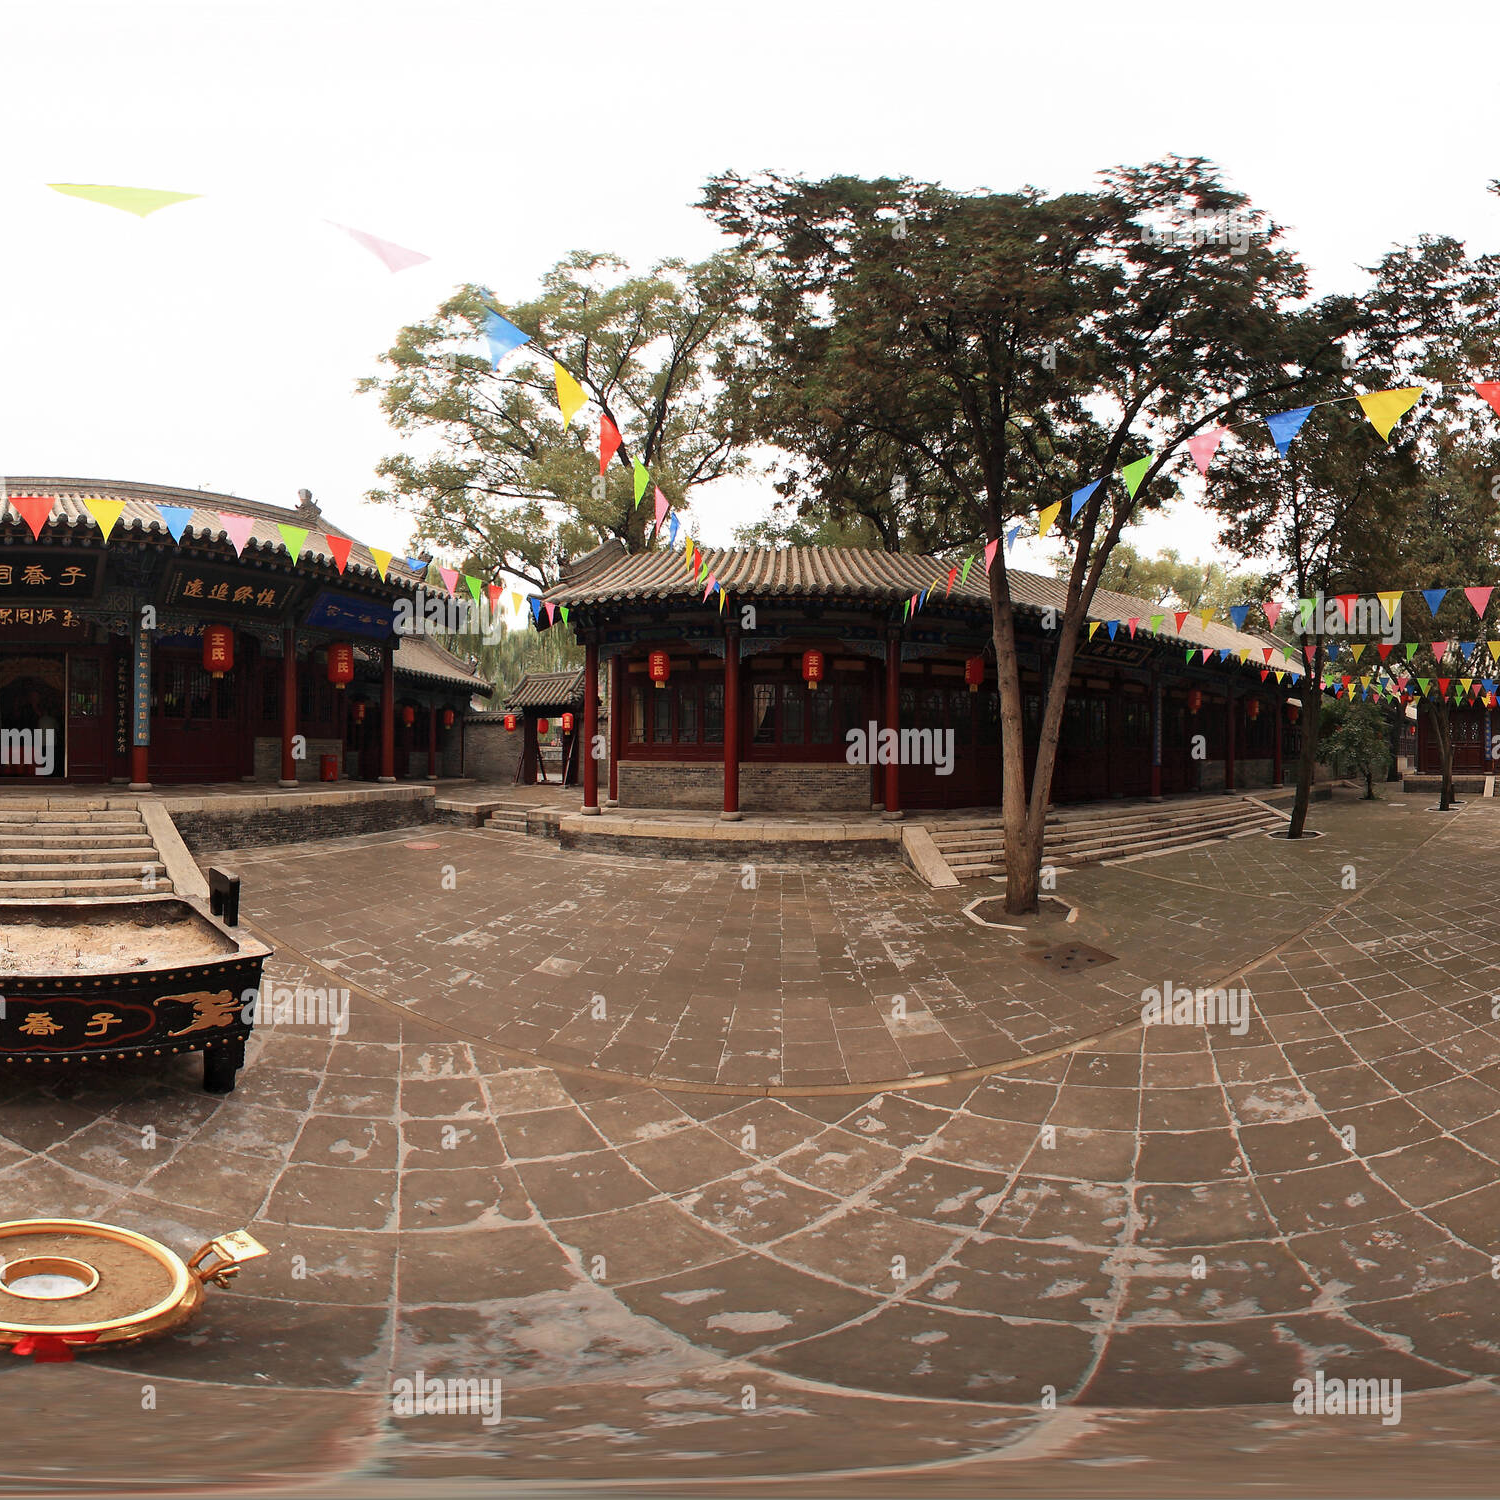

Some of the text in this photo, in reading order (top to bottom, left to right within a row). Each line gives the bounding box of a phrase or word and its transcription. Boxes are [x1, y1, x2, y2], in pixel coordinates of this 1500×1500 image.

[211, 633, 225, 660] 王氏
[337, 649, 349, 673] 王氏
[654, 655, 664, 676] 王氏
[808, 655, 818, 676] 王氏
